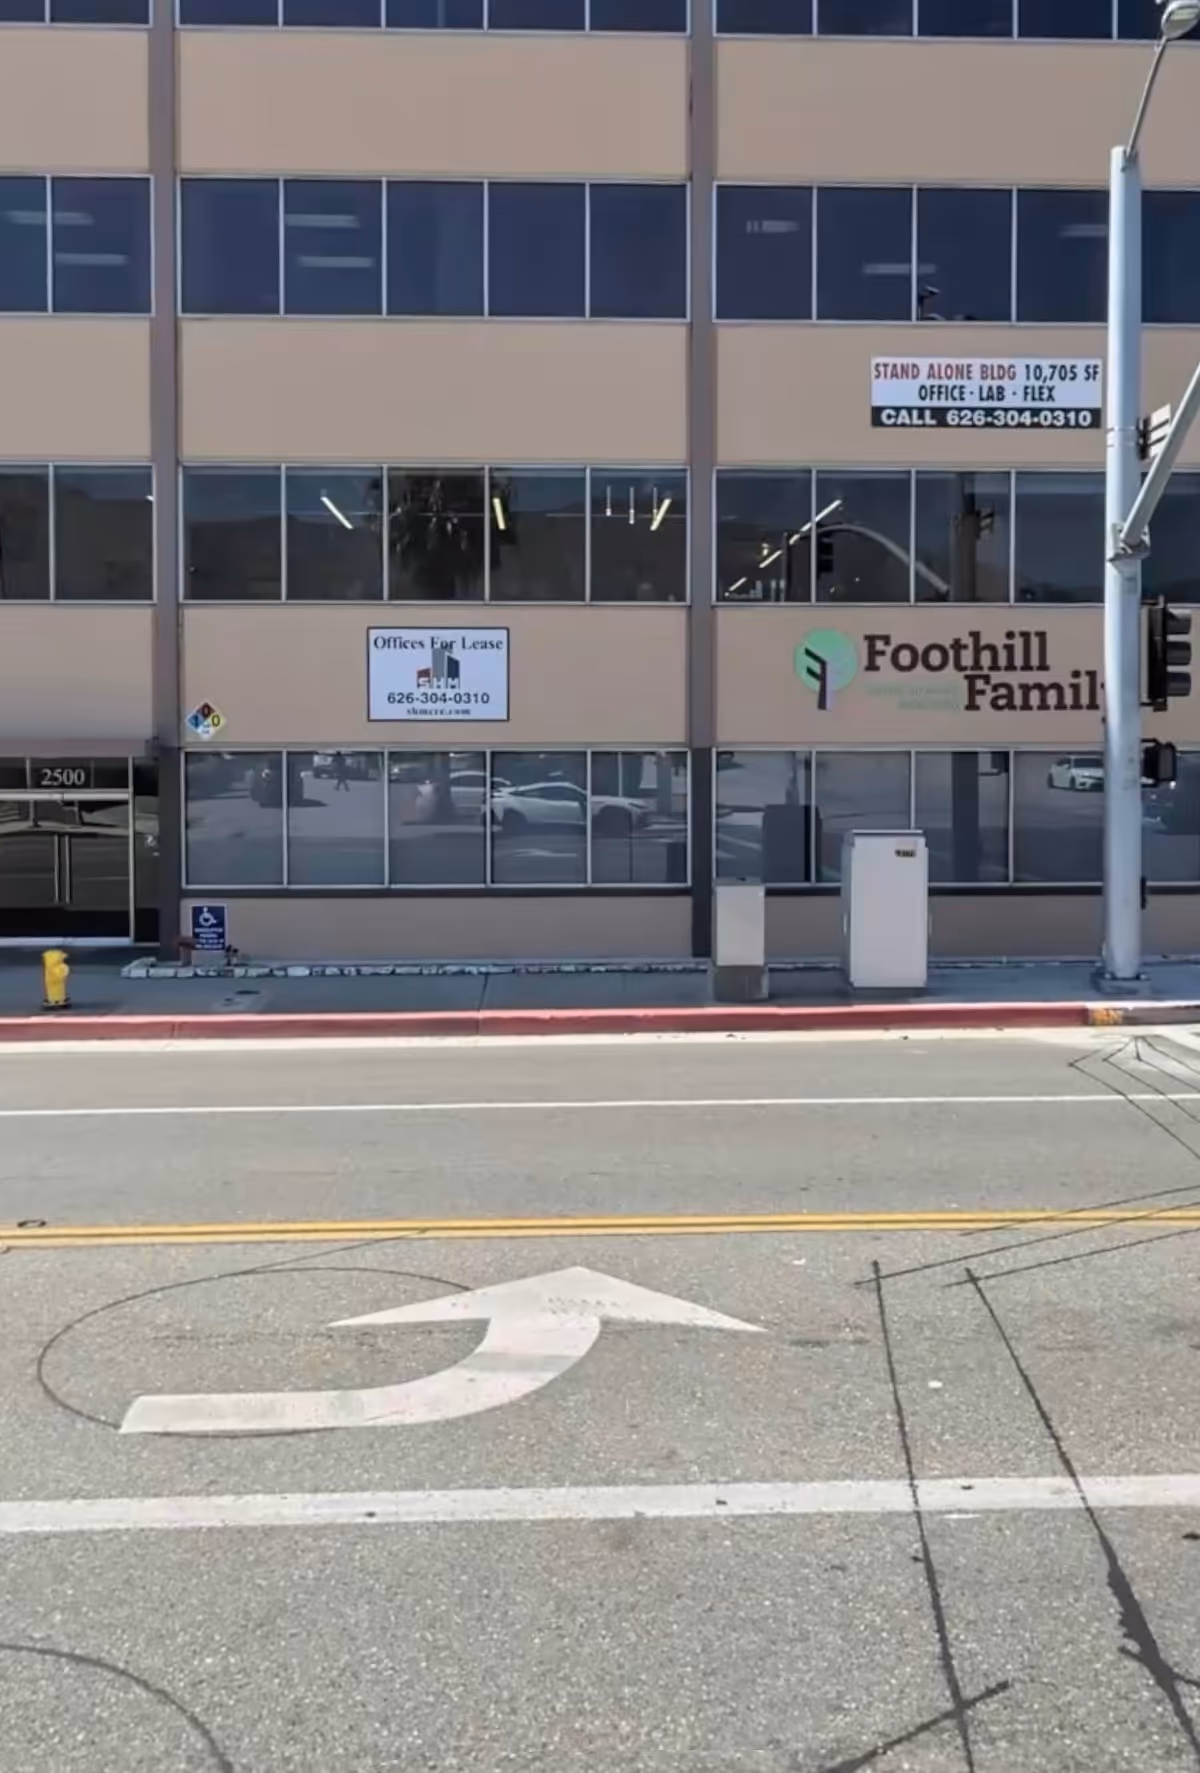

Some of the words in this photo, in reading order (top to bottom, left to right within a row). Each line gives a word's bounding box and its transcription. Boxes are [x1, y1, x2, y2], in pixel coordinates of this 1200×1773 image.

[874, 363, 919, 380] STAND
[927, 363, 972, 380] ALONE
[980, 364, 1017, 381] BLDG
[1025, 364, 1077, 383] 10,705
[1084, 364, 1099, 381] SF
[918, 384, 965, 401] OFFICE
[979, 385, 1005, 402] LAB
[1023, 385, 1055, 402] FLEX
[880, 409, 936, 425] CALL
[373, 636, 425, 650] Offices
[430, 636, 456, 650] For
[461, 636, 503, 650] Lease
[863, 631, 1050, 672] Foothill
[387, 692, 490, 704] 626-304-0310
[963, 669, 1105, 711] Famil
[41, 768, 85, 786] 2500
